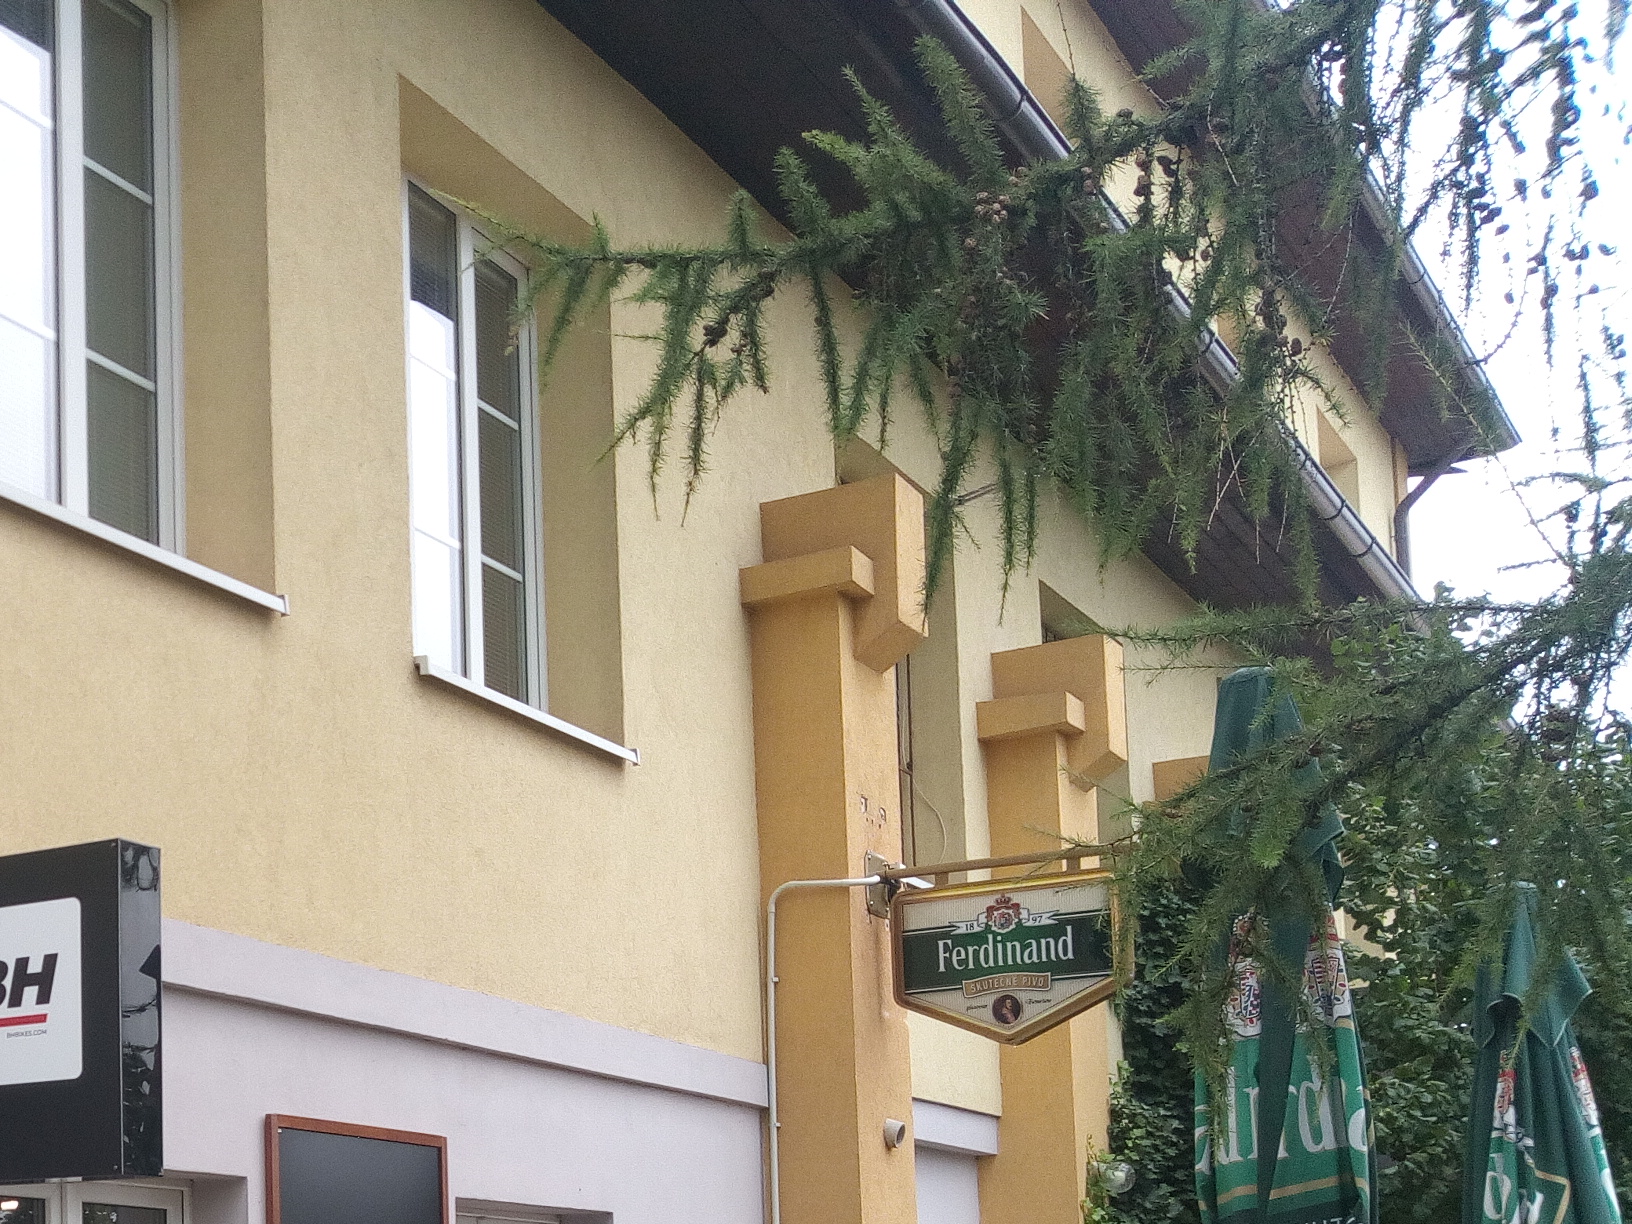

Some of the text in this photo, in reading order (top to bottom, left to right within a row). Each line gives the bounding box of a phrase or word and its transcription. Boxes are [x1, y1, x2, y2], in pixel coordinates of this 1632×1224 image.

[965, 916, 1043, 932] 18 97
[937, 925, 1075, 972] Ferdinand
[1022, 976, 1045, 987] PIVO
